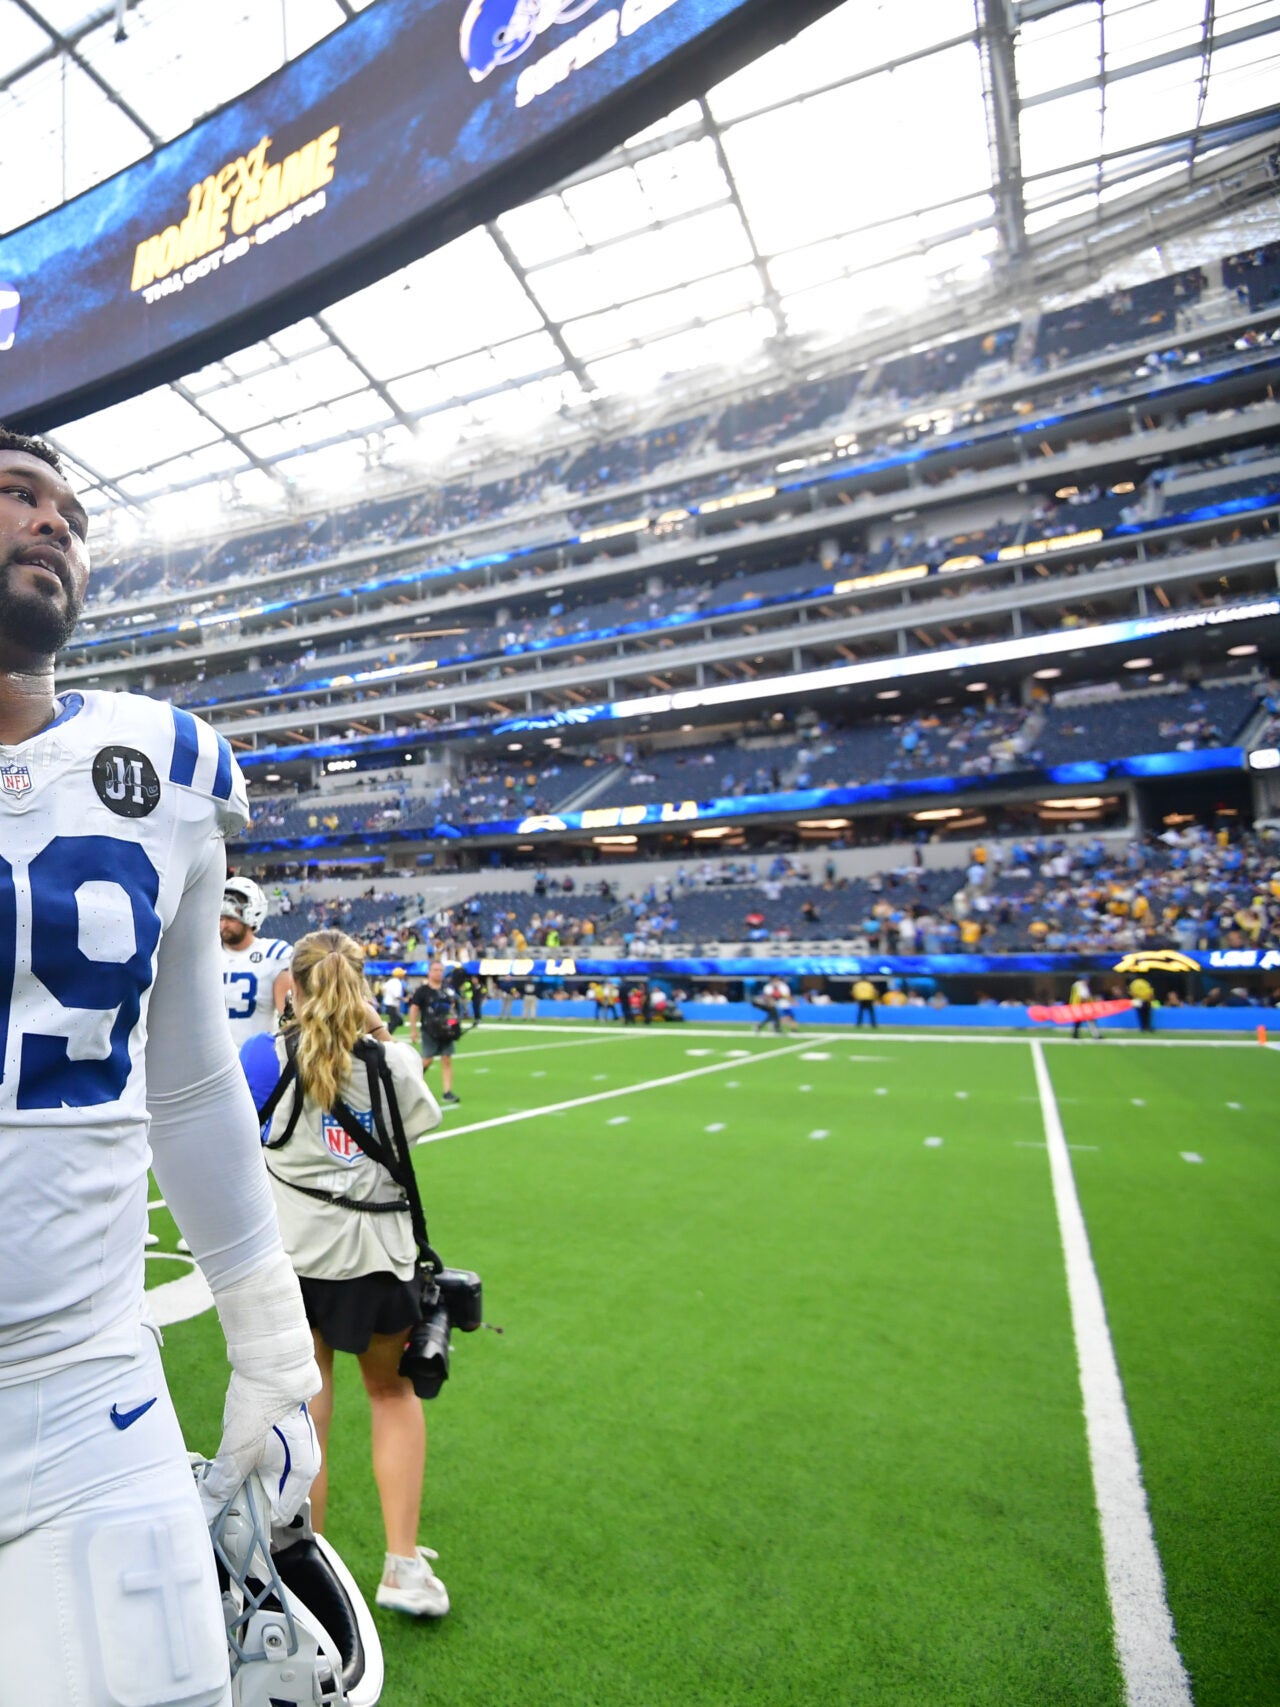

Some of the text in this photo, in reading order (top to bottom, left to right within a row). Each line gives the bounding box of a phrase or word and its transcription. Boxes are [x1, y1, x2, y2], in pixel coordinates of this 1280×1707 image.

[130, 125, 340, 292] HOME GAME
[5, 775, 29, 790] NFL
[223, 972, 257, 1018] 3
[327, 1128, 363, 1156] NF
